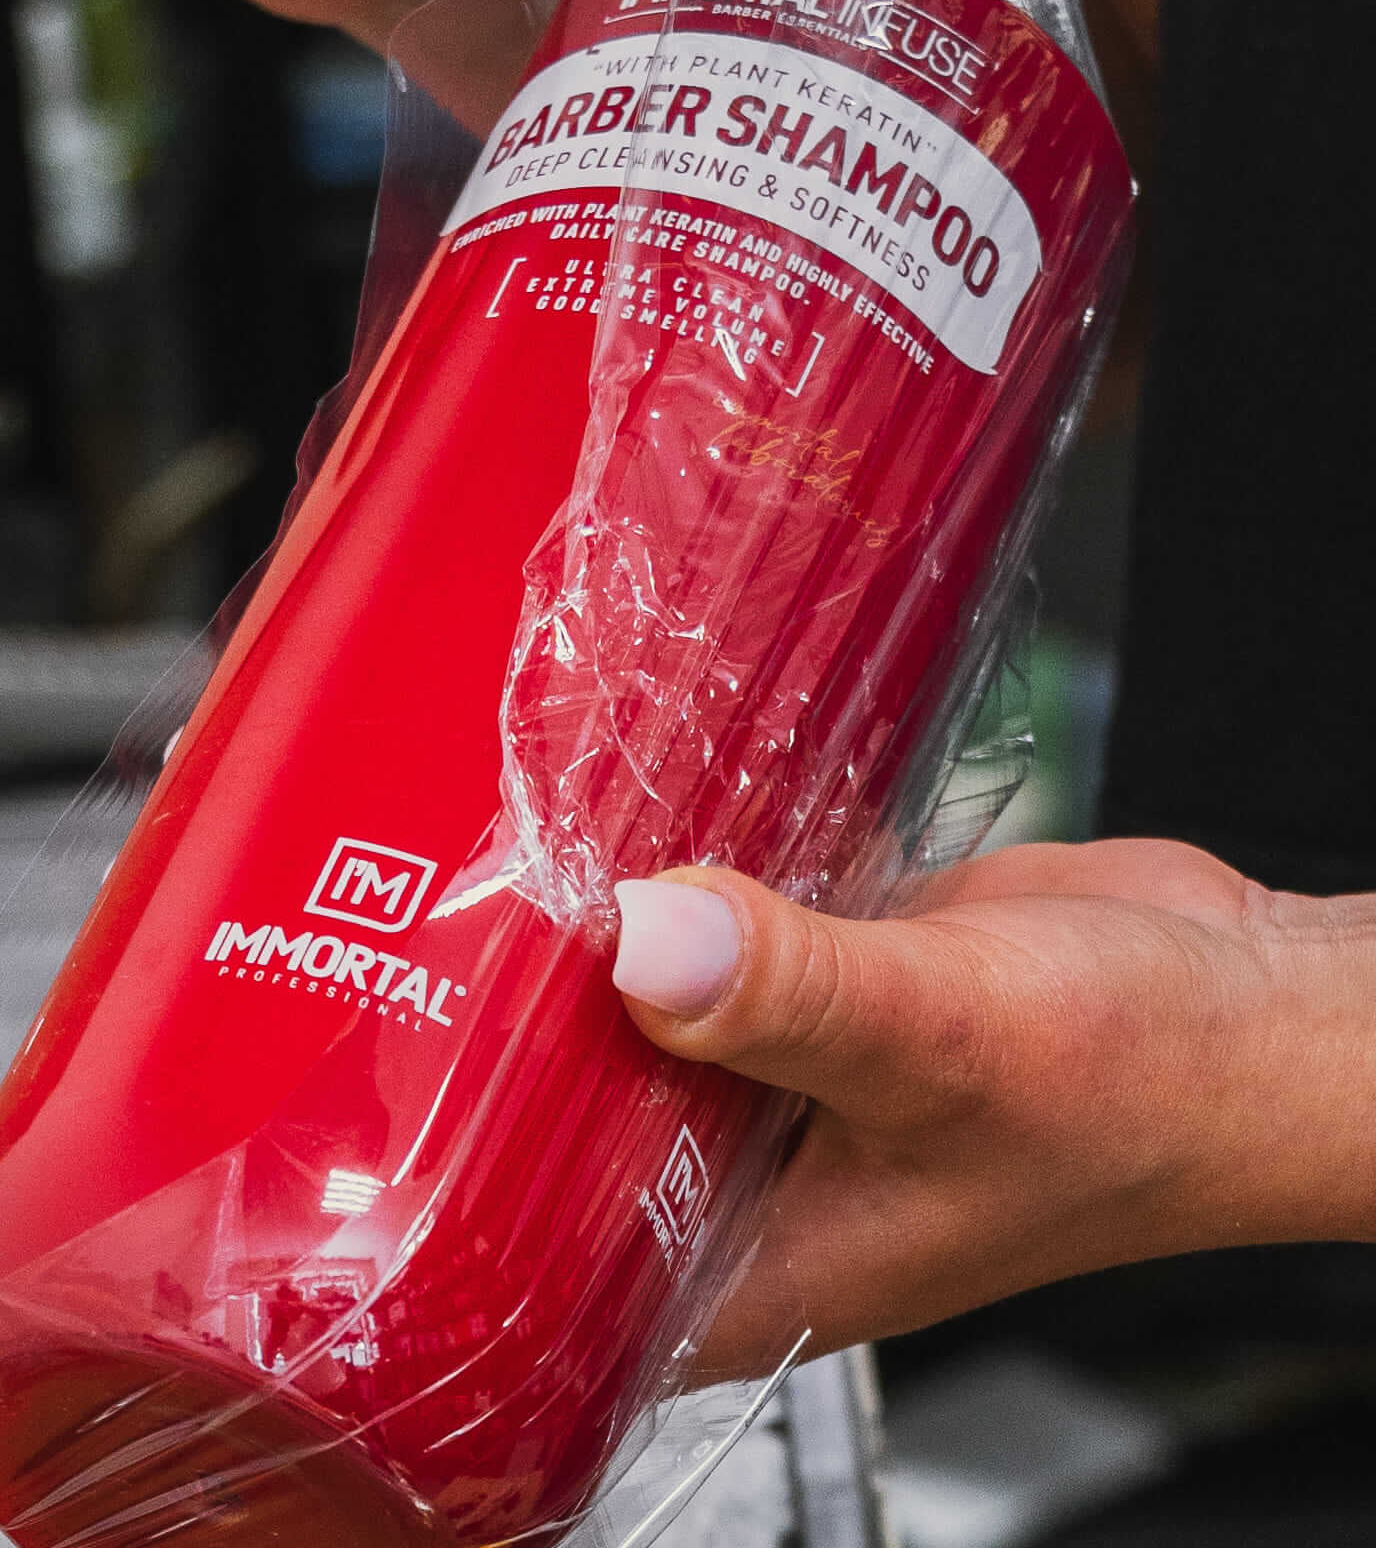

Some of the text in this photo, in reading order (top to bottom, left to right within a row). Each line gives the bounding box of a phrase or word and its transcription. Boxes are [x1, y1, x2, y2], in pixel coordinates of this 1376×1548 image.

[711, 3, 772, 22] BARBER
[688, 55, 791, 89] PLANT
[484, 83, 1001, 299] BARBER SHAMPOO
[505, 146, 931, 292] DEEP CLEANSING & SOFTNESS
[451, 203, 935, 377] ENRICHED WITH PLANT KERATIN AND HIGHLY EFFECTIVE
[549, 222, 812, 307] DAILY CARE SHAMPOO.
[564, 258, 765, 323] ULTRA CLEAN
[526, 276, 786, 358] EXTREME VOLUME
[535, 294, 603, 315] GOOD
[330, 856, 411, 915] I'M
[205, 921, 453, 1028] IMMORTAL
[218, 965, 423, 1032] PROFESSIONAL
